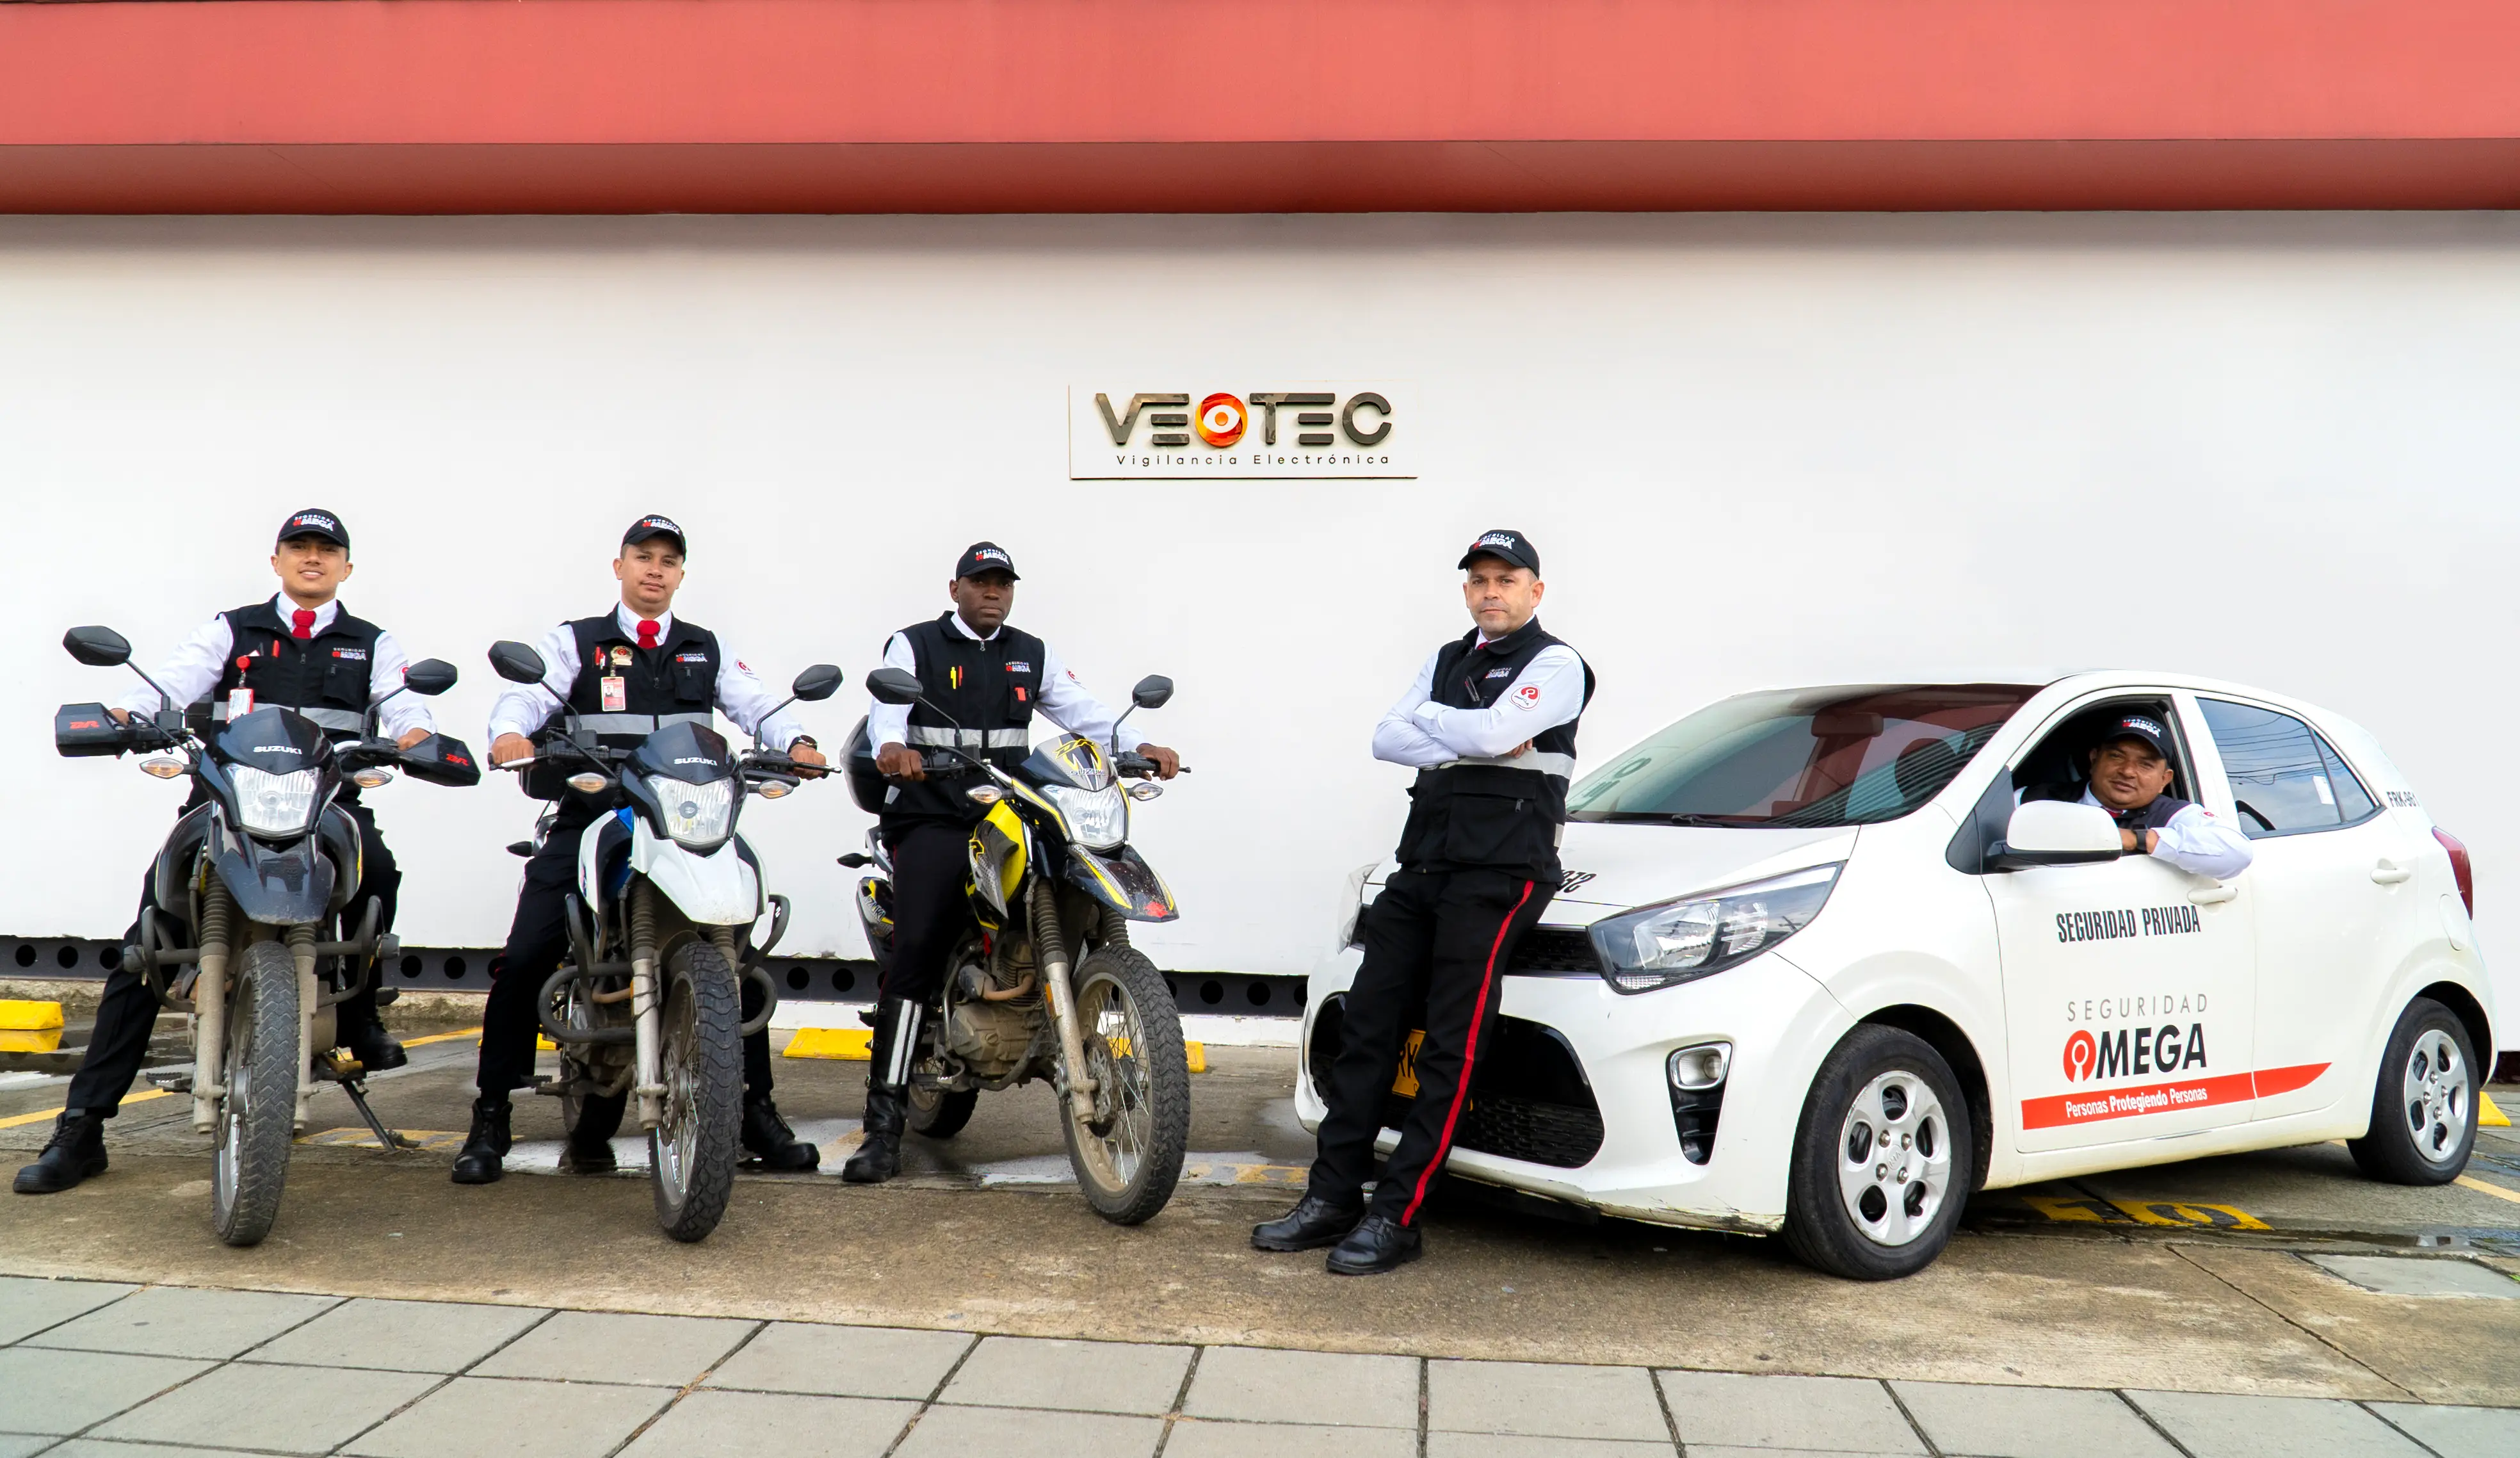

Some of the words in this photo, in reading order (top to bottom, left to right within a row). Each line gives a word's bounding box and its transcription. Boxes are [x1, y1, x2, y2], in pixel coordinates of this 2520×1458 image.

[1094, 393, 1391, 447] VEOTEC
[1117, 455, 1238, 467] Vigilancia
[1254, 453, 1389, 465] Electrónica
[253, 745, 302, 754] SUZUKI
[674, 757, 718, 766] SUZUKI
[1070, 768, 1106, 776] SUZUKI
[2056, 909, 2136, 943] SEGURIDAD
[2142, 905, 2201, 936] PRIVADA
[2067, 994, 2208, 1021] SEGURIDAD
[2063, 1023, 2208, 1083] OMEGA
[2065, 1101, 2108, 1118] Personas
[2109, 1090, 2169, 1113] Protegiendo
[2169, 1088, 2208, 1104] Personas
